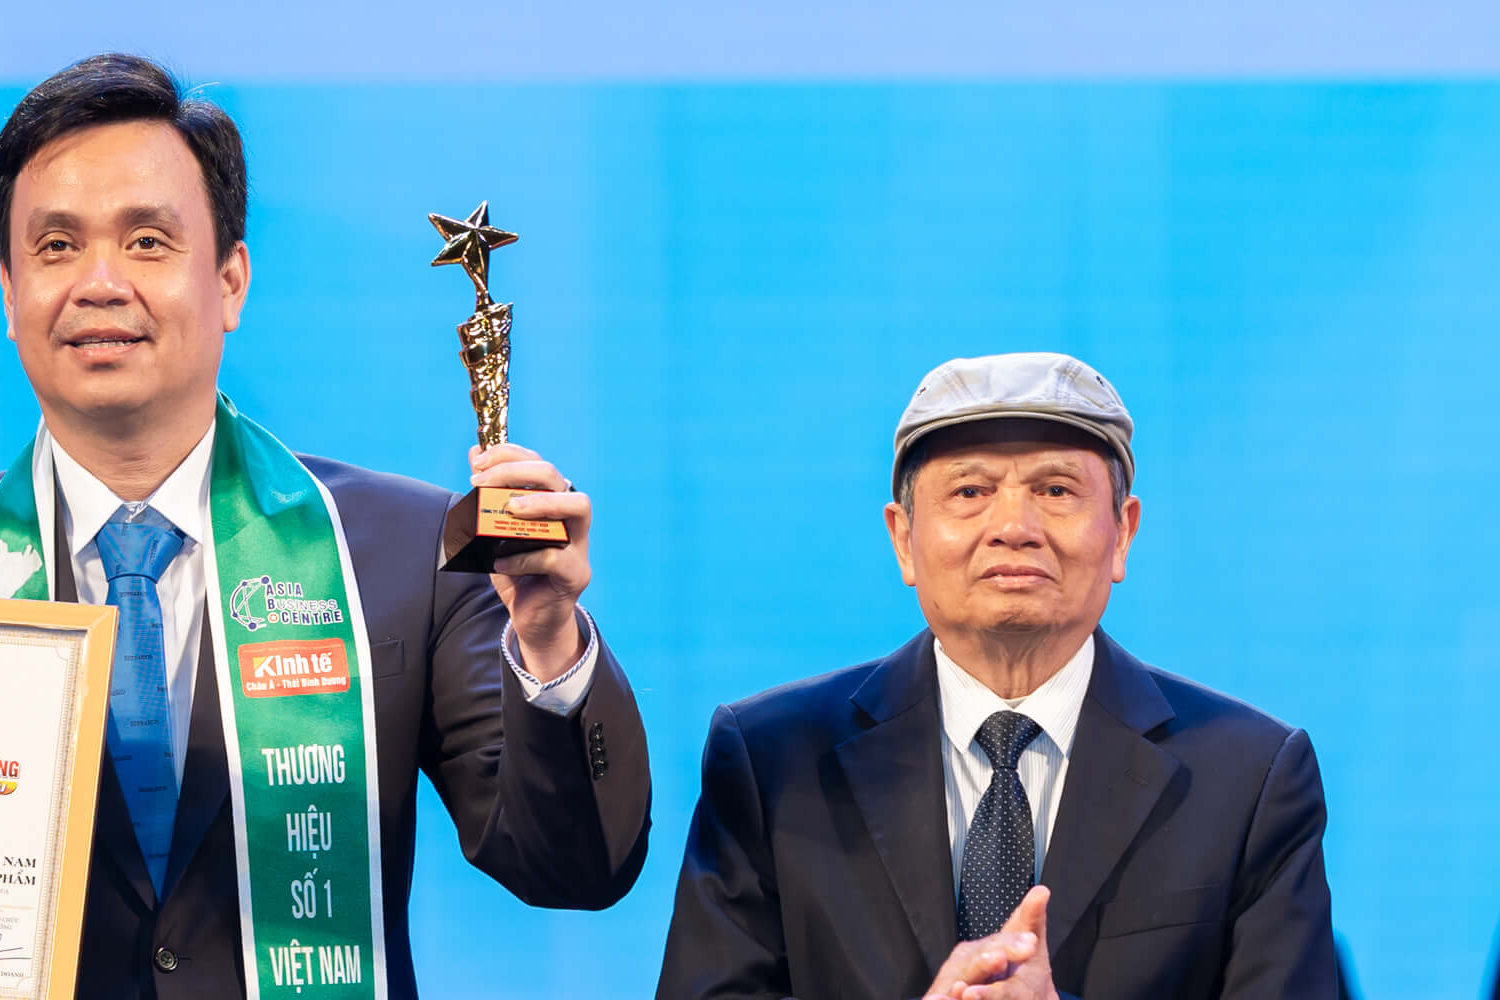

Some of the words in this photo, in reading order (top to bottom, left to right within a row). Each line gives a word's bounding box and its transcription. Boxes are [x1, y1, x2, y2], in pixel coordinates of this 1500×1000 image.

[265, 582, 303, 597] ASIA
[267, 598, 338, 611] BUSINESS
[281, 610, 343, 625] CENTRE
[311, 651, 333, 674] tế
[261, 743, 345, 786] THƯƠNG
[286, 804, 332, 859] HIỆU
[3, 856, 36, 868] NAM
[291, 867, 318, 919] SỐ
[323, 879, 333, 918] 1
[269, 938, 313, 993] VIỆT
[318, 945, 362, 984] NAM
